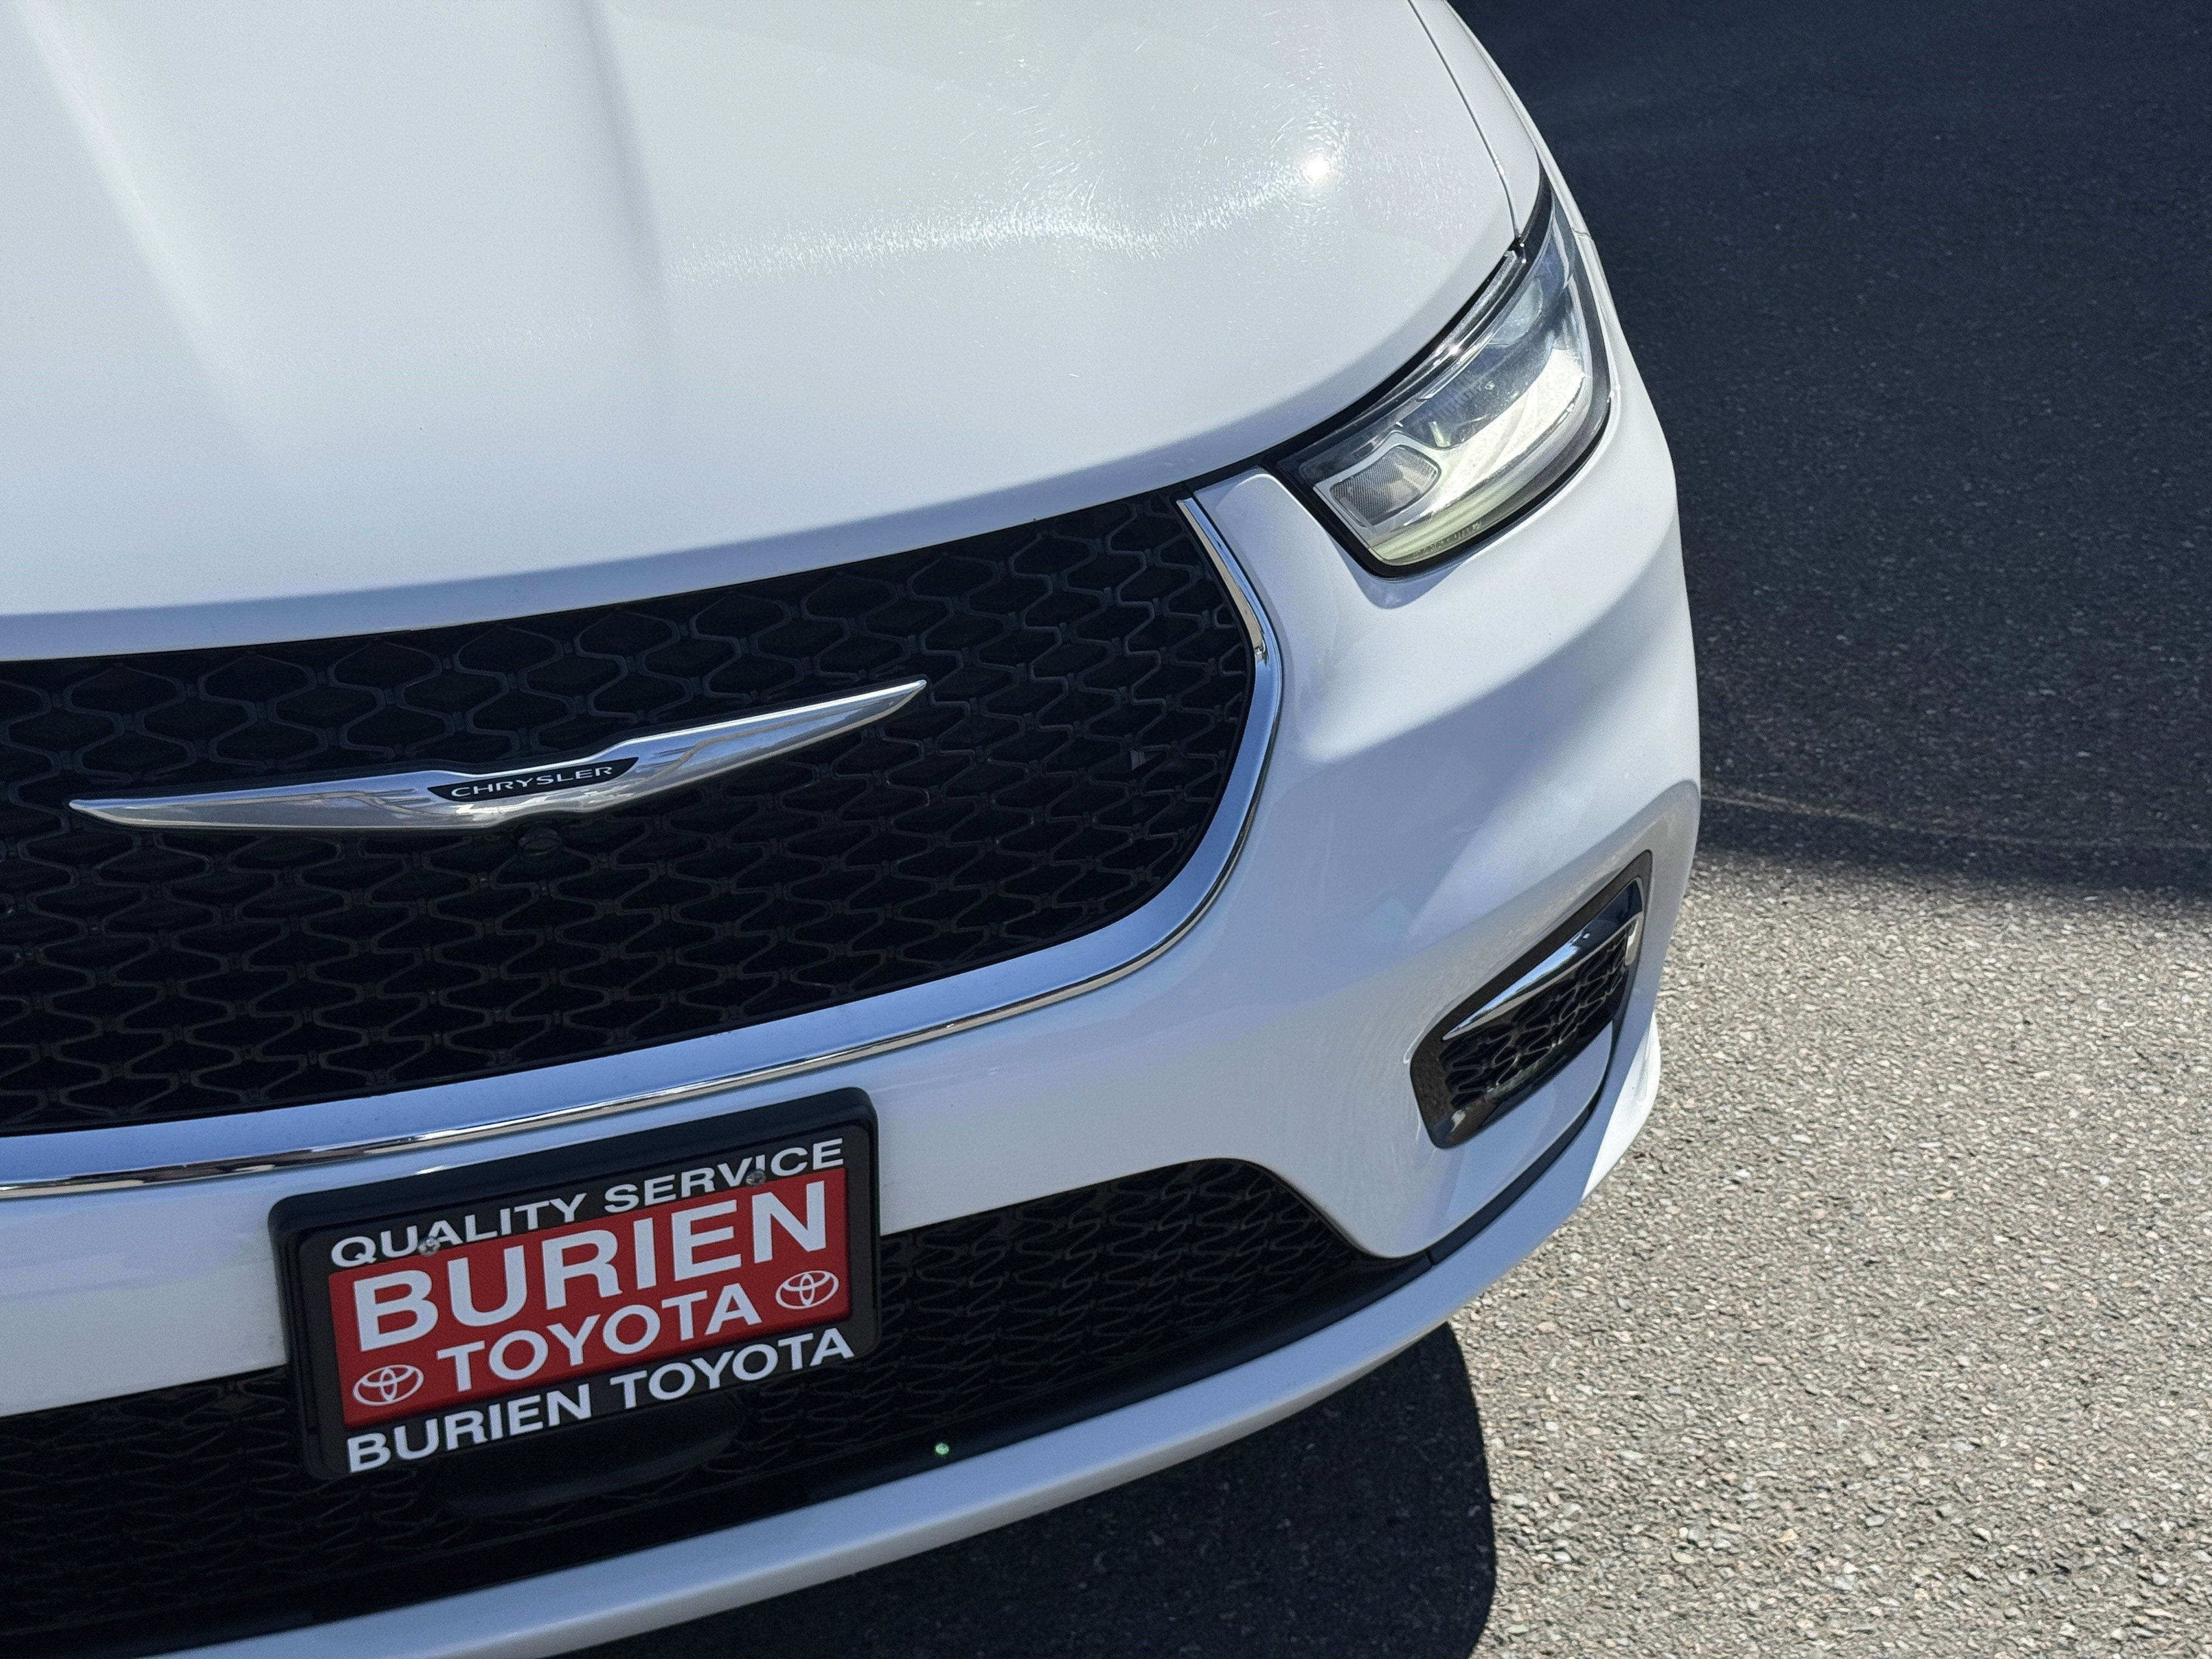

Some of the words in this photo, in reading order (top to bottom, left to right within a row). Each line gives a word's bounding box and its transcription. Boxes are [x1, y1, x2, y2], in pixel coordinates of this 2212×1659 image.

[451, 766, 612, 797] CHRYSLER
[331, 1193, 586, 1268] QUALITY
[604, 1138, 844, 1214] SERVICE
[353, 1180, 827, 1352] BURIEN
[347, 1383, 592, 1473] BURIEN
[609, 1328, 854, 1409] TOYOTA
[437, 1283, 762, 1392] TOYOTA
